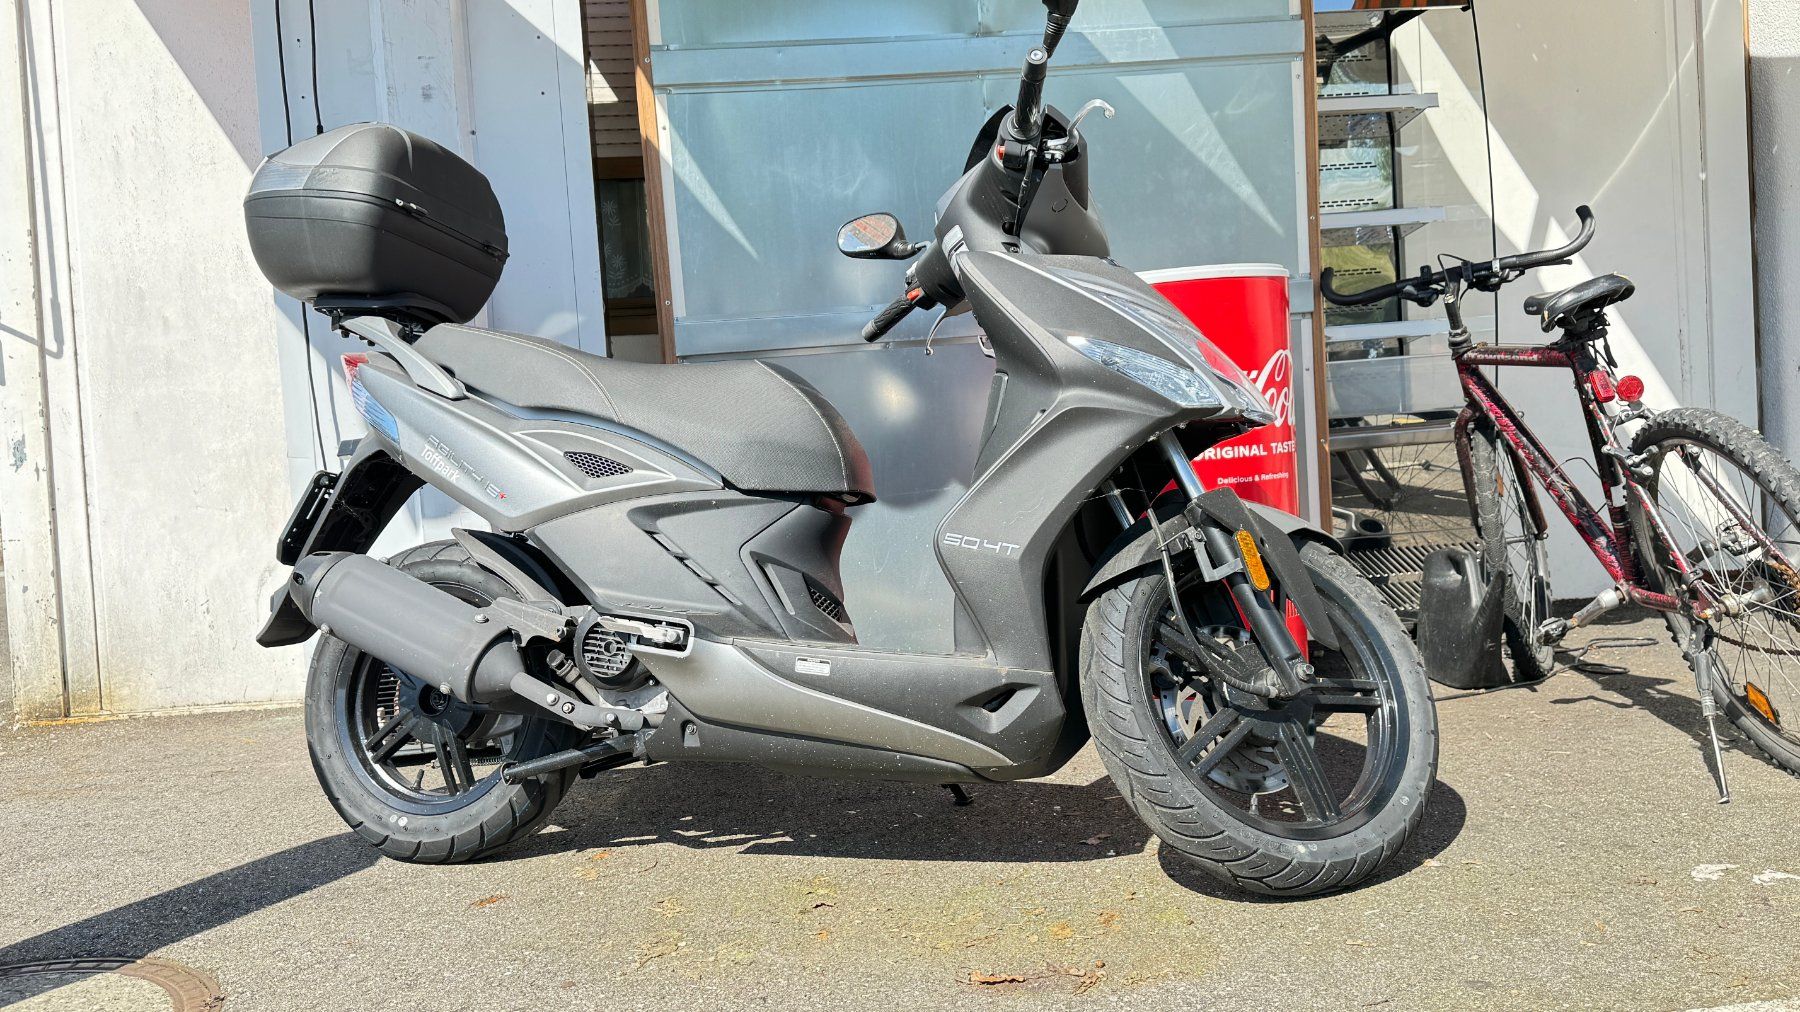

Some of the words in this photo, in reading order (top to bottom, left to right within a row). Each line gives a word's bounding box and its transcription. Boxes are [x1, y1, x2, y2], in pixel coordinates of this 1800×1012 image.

[427, 434, 484, 482] AGILITY
[1270, 440, 1296, 454] TASTE
[421, 444, 460, 483] Toffpark
[1217, 475, 1252, 485] Delicious
[1254, 474, 1260, 482] &
[1260, 471, 1289, 482] Refreshing
[943, 532, 981, 550] 50
[983, 539, 1021, 556] 4T
